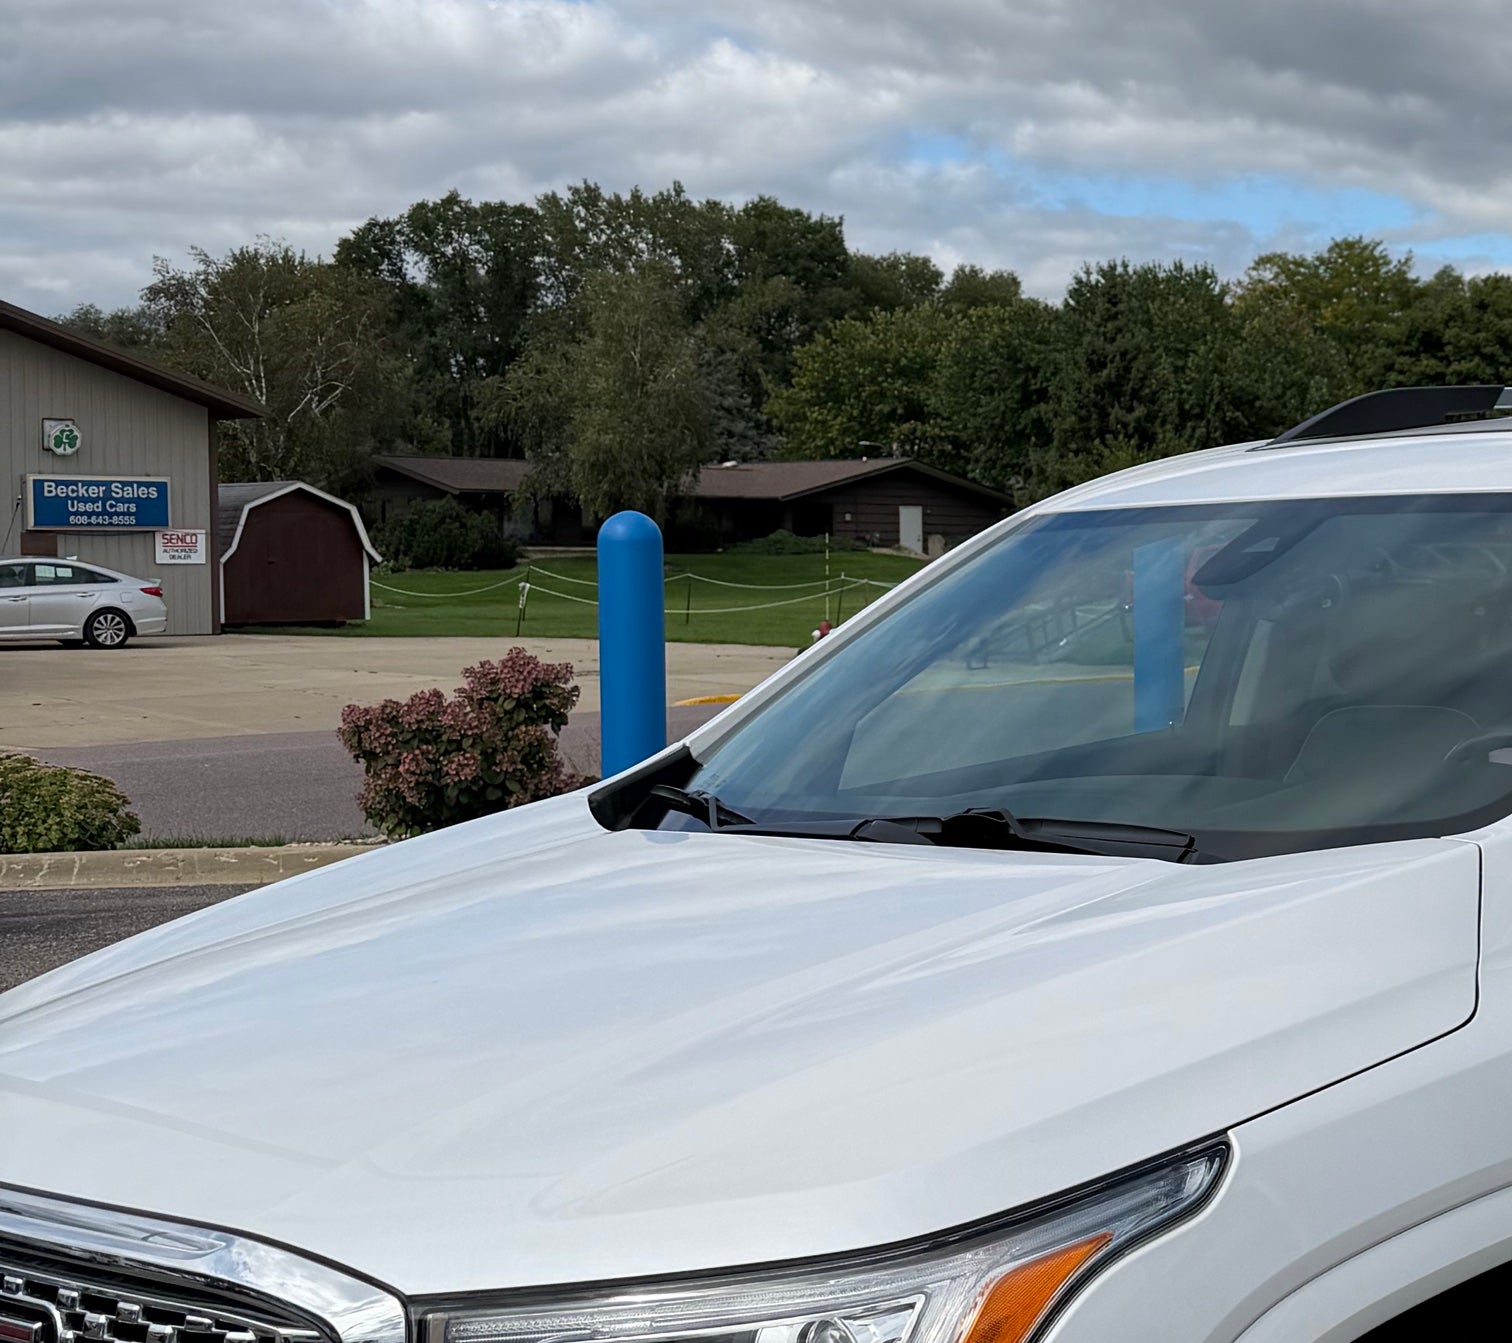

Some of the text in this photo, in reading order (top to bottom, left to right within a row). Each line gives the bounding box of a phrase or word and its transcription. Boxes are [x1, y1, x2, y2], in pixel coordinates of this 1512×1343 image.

[43, 481, 158, 499] Becker Sales
[67, 500, 137, 513] Used Cars
[162, 533, 198, 545] SENCO
